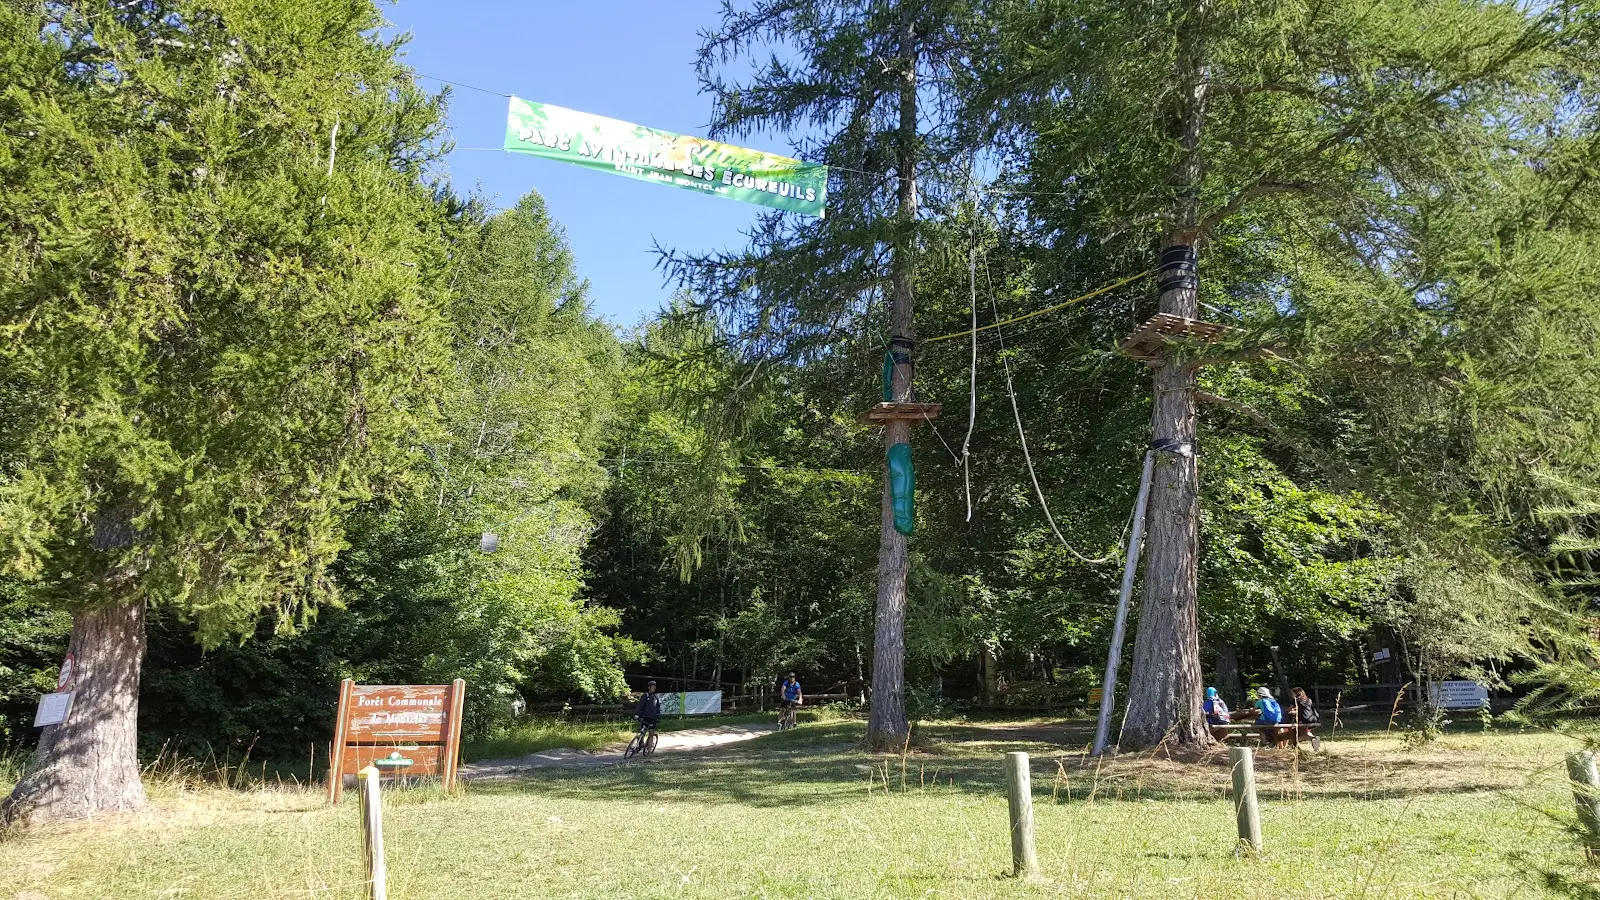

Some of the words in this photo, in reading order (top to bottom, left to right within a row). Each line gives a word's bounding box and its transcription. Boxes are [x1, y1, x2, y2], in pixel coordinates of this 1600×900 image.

[517, 126, 571, 151] PARC
[577, 140, 676, 172] AVENTURE
[682, 163, 716, 182] LES
[721, 167, 817, 203] ÉCUREUILS
[615, 163, 644, 176] SAINT
[648, 171, 673, 183] JEAN
[675, 177, 728, 194] MONTCLAR
[359, 696, 384, 706] Forêt
[388, 695, 442, 706] Communale
